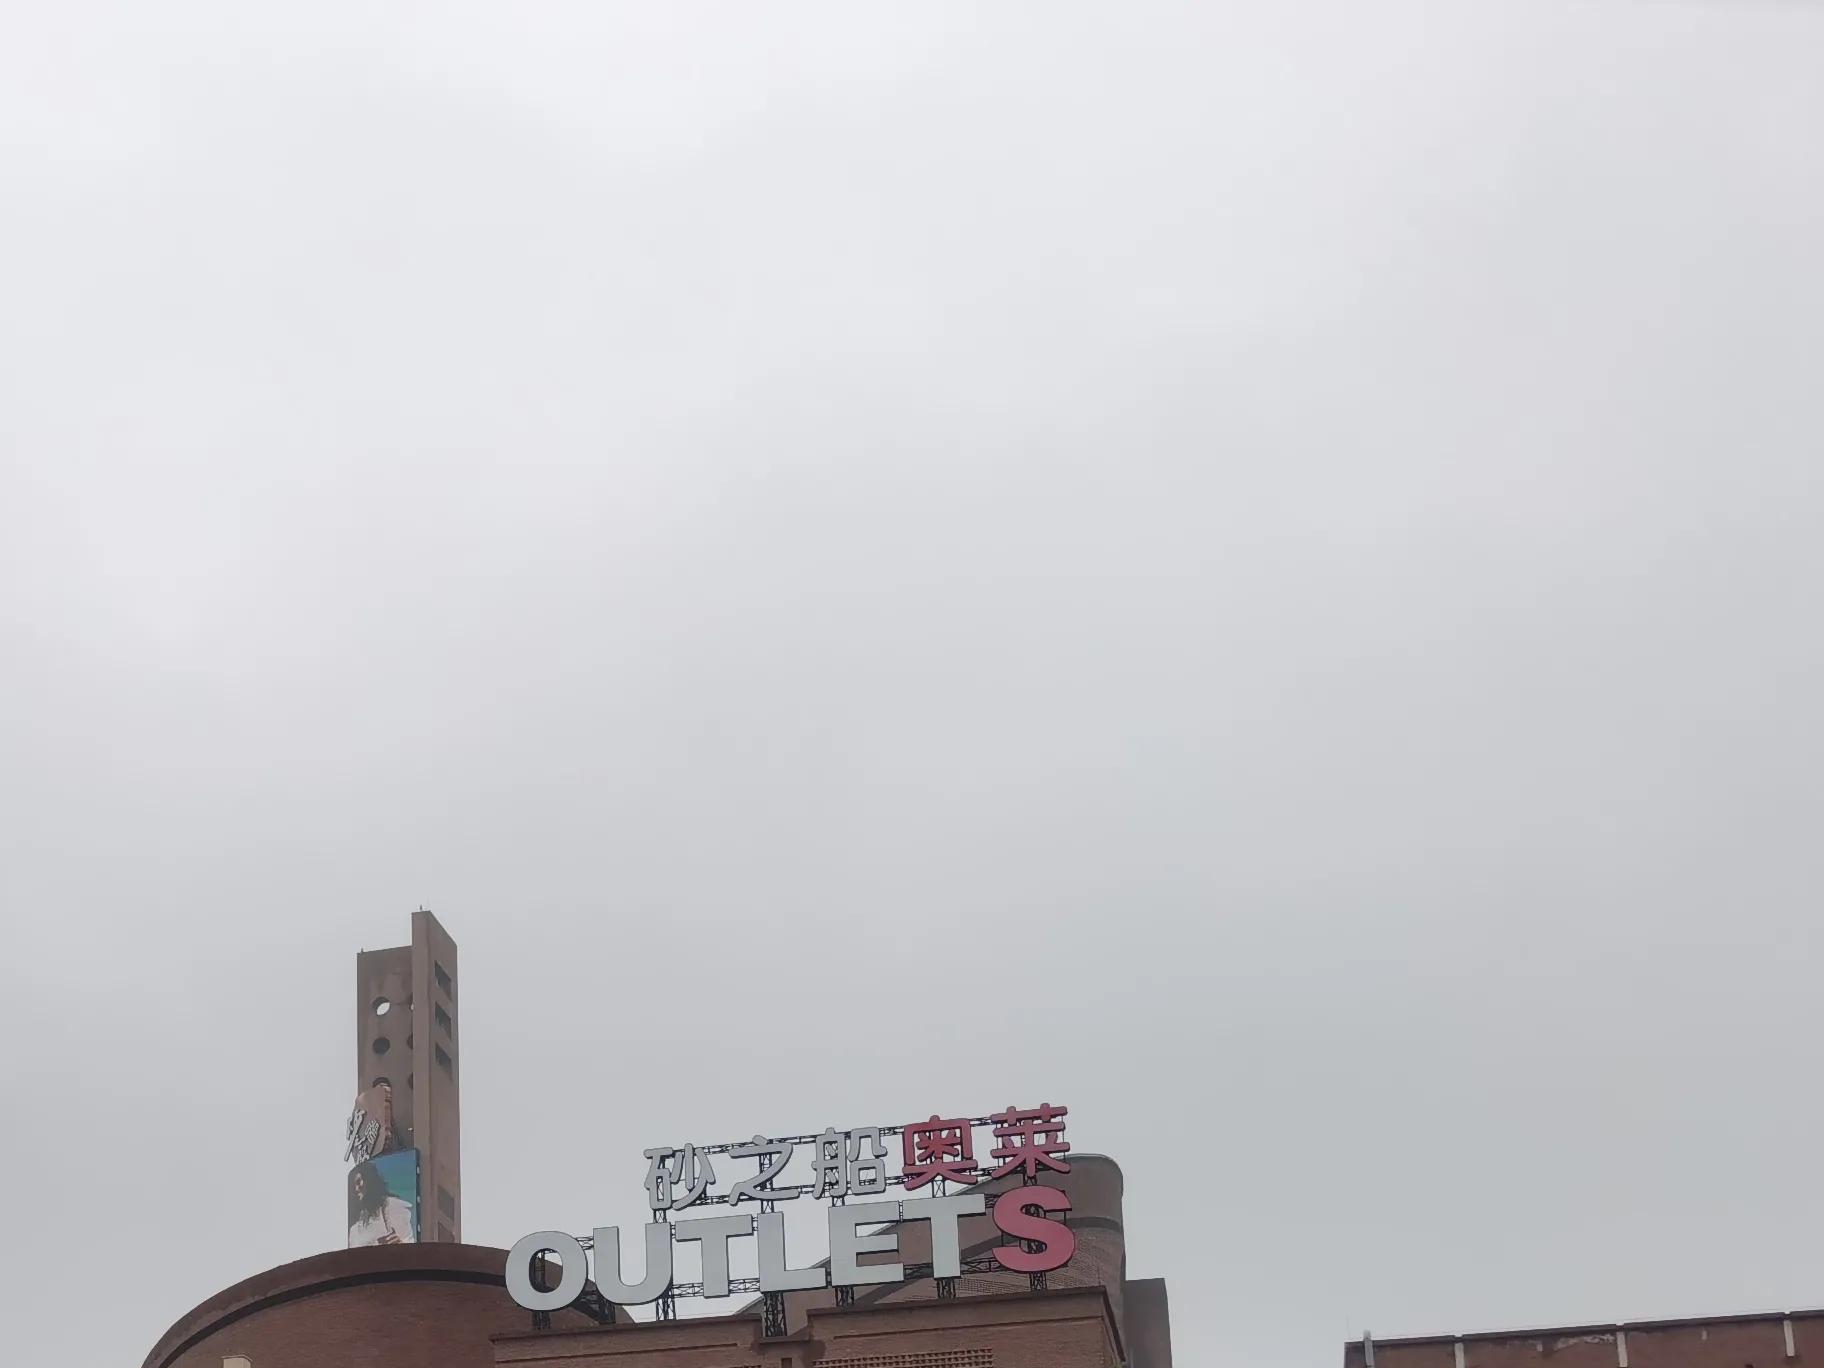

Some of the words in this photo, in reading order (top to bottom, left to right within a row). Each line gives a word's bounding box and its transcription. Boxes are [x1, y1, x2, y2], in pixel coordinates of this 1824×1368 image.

[643, 1103, 1072, 1211] 砂之船奥莱
[505, 1185, 1076, 1311] OUTLETS
